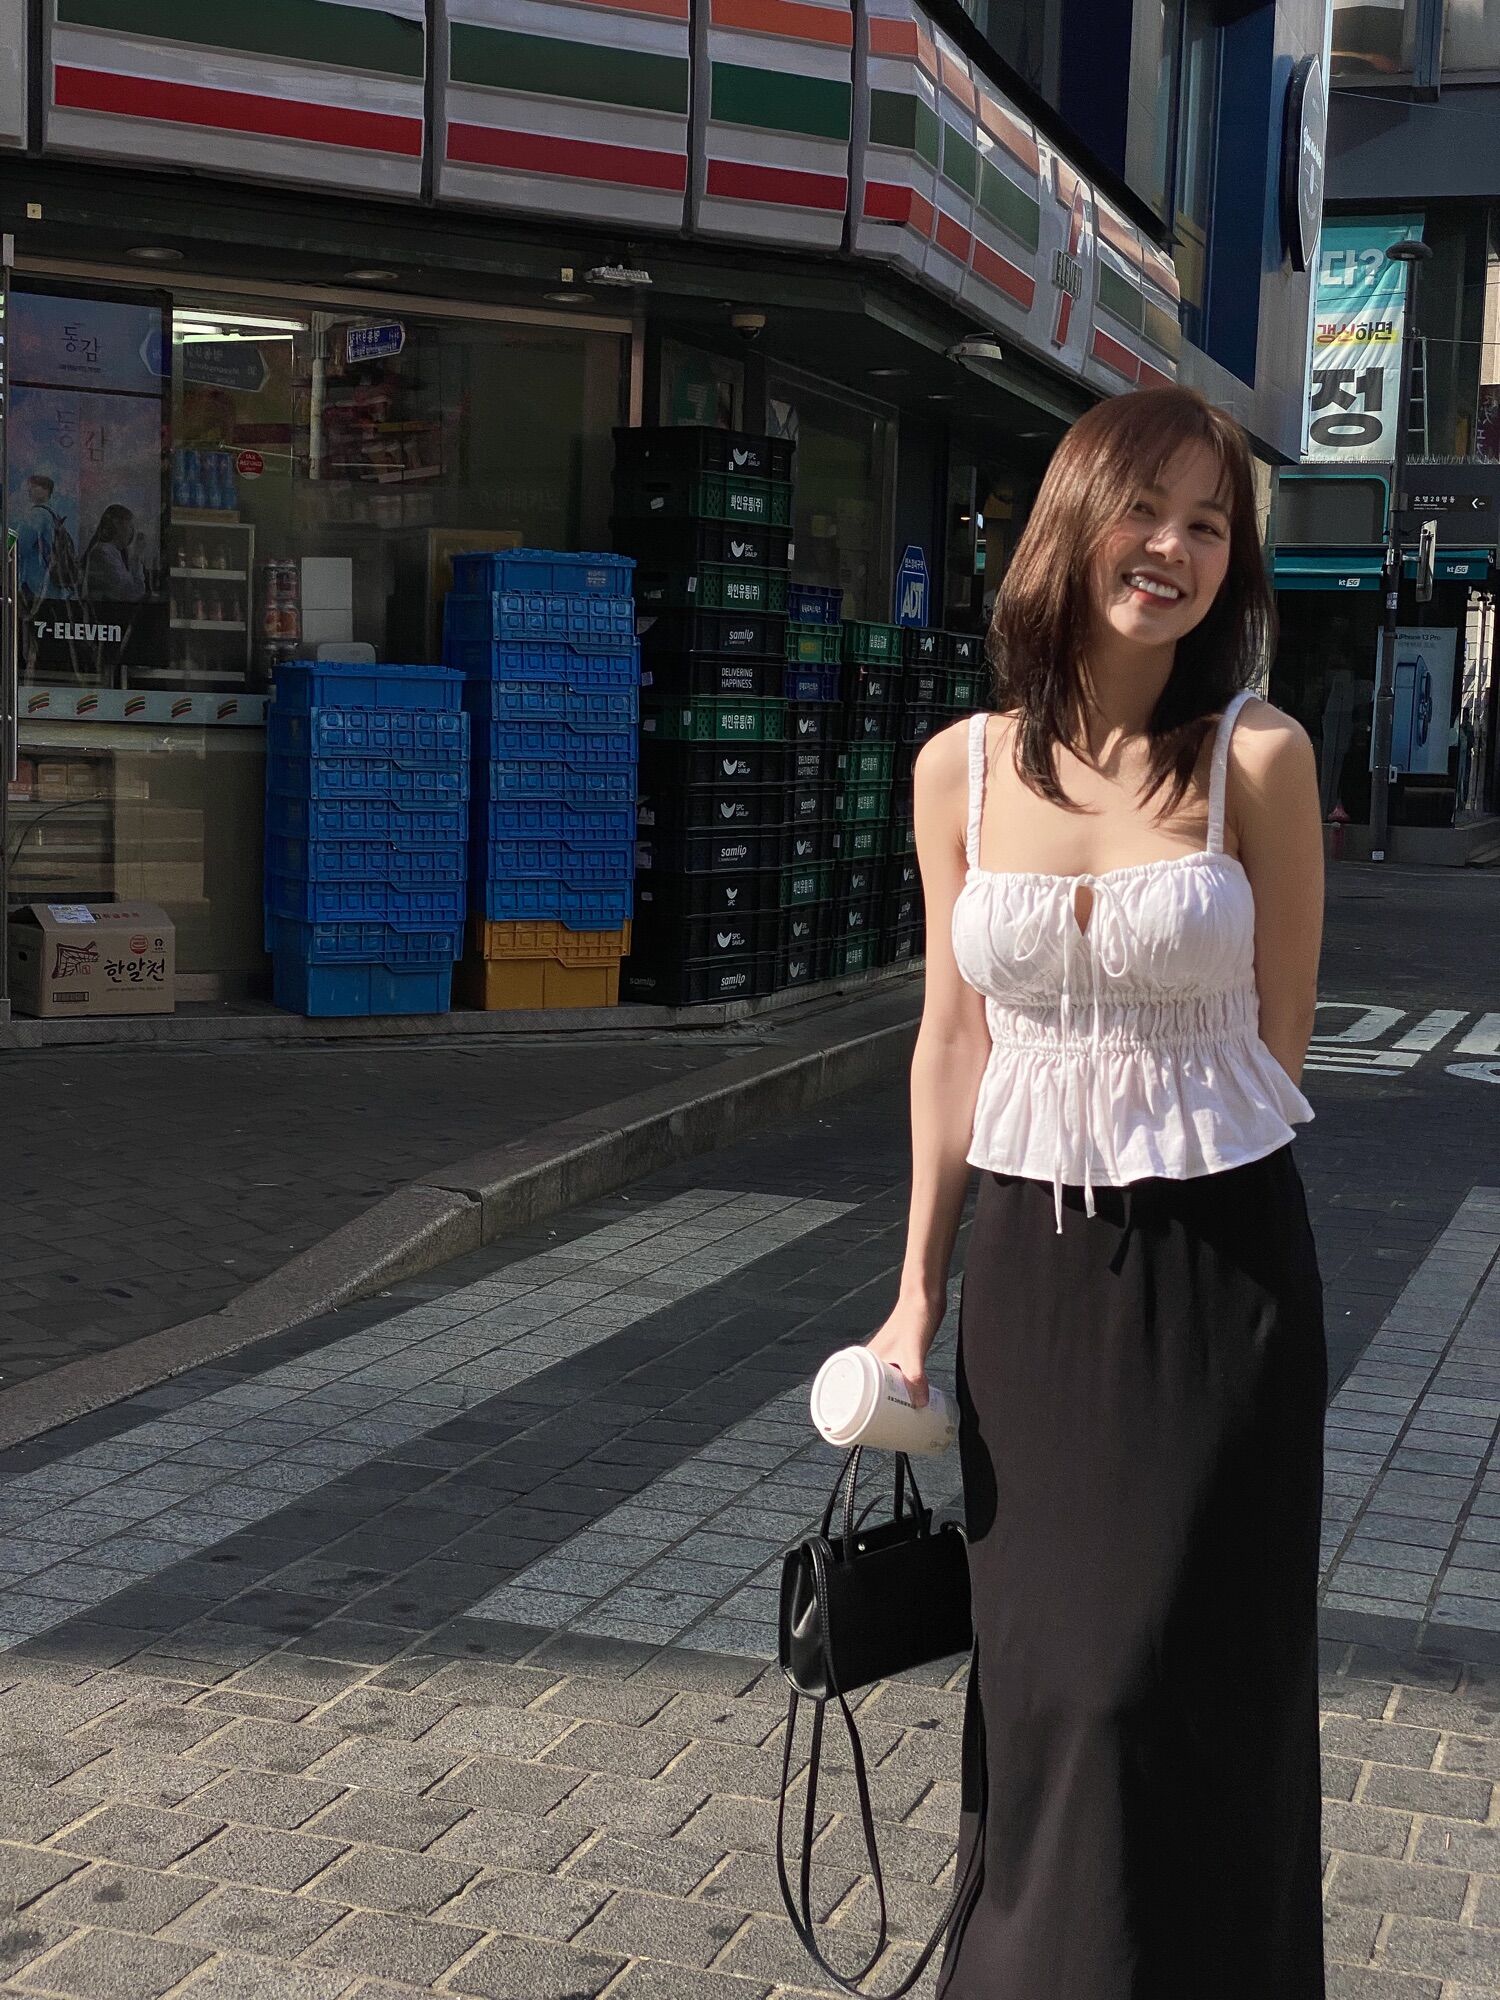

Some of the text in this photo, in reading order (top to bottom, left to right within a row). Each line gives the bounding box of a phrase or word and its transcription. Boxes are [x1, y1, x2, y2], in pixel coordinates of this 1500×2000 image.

[1321, 248, 1384, 286] 다?
[1316, 320, 1392, 344] 갱신하면
[61, 325, 98, 362] 동감
[1310, 366, 1385, 448] 정
[727, 583, 760, 600] 화인유통(주)
[901, 580, 924, 619] ADT
[34, 621, 122, 642] 7-ELEVEN
[729, 629, 754, 643] samlip
[721, 667, 753, 678] DELIVERING
[721, 678, 753, 689] HAPPINESS
[721, 714, 756, 731] 화인유통(주)
[721, 845, 747, 858] samlip
[721, 973, 746, 987] samlip
